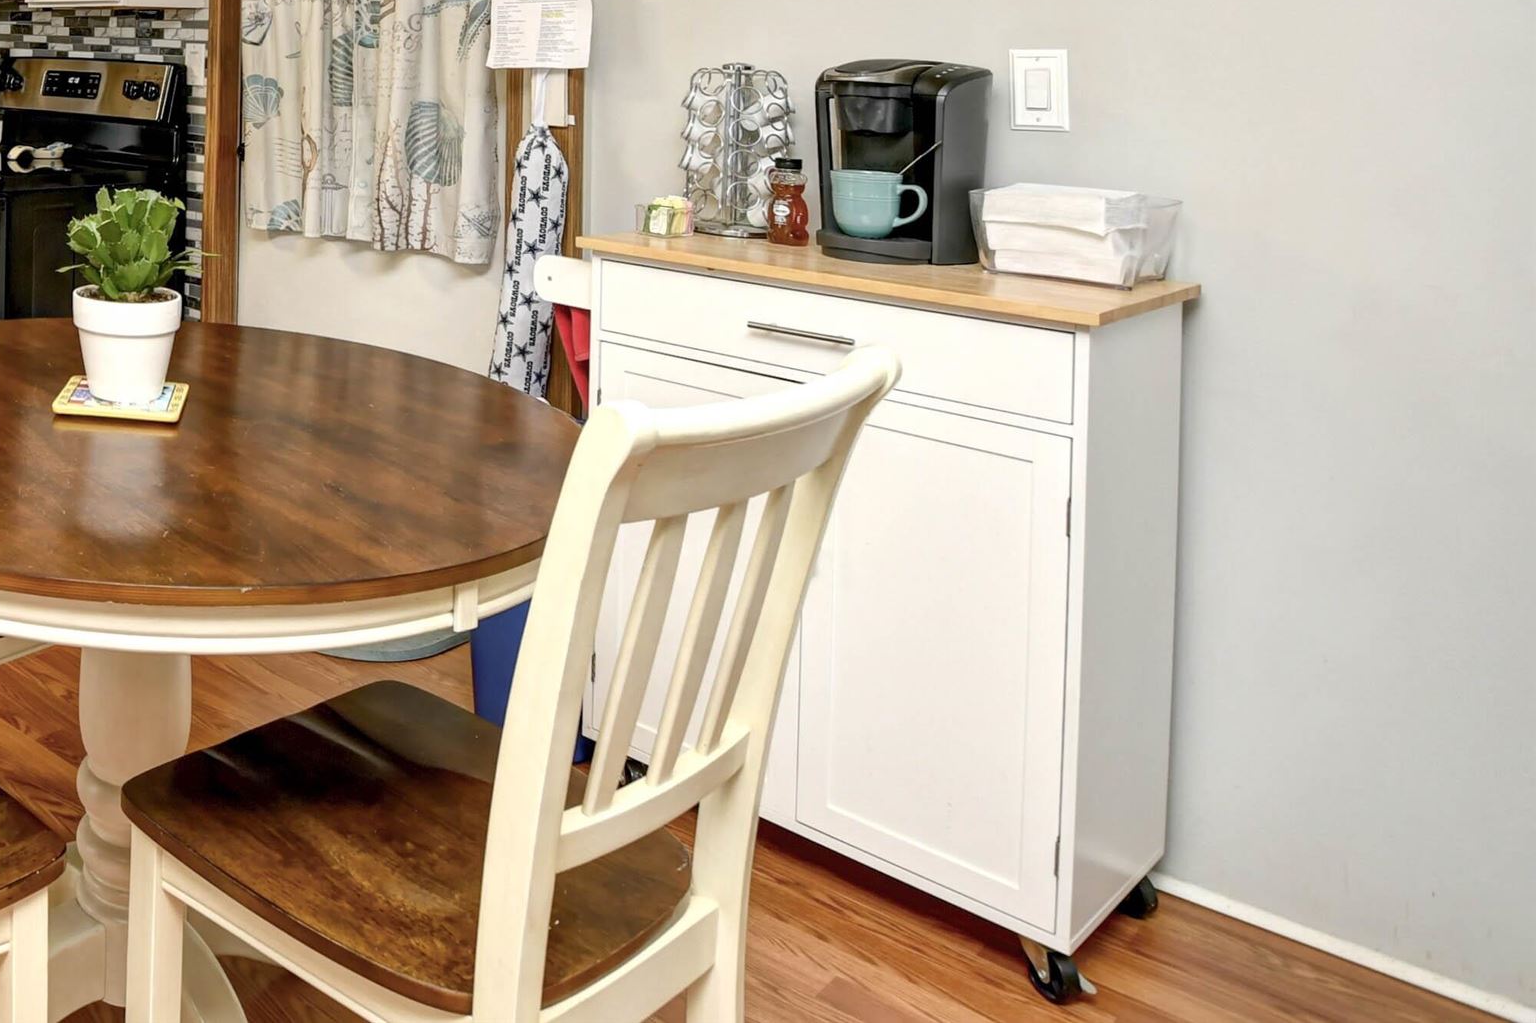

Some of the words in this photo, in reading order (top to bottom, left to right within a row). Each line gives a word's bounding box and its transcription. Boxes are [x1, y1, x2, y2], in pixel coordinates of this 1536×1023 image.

[542, 153, 552, 192] COWBOYS
[518, 175, 528, 214] COWBOYS
[538, 206, 549, 245] COWBOYS
[514, 227, 524, 266] COWBOYS
[509, 279, 520, 318] COWBOYS
[528, 309, 539, 347] COWBOYS
[503, 330, 514, 369] COWBOYS
[523, 360, 534, 395] COWBOY
